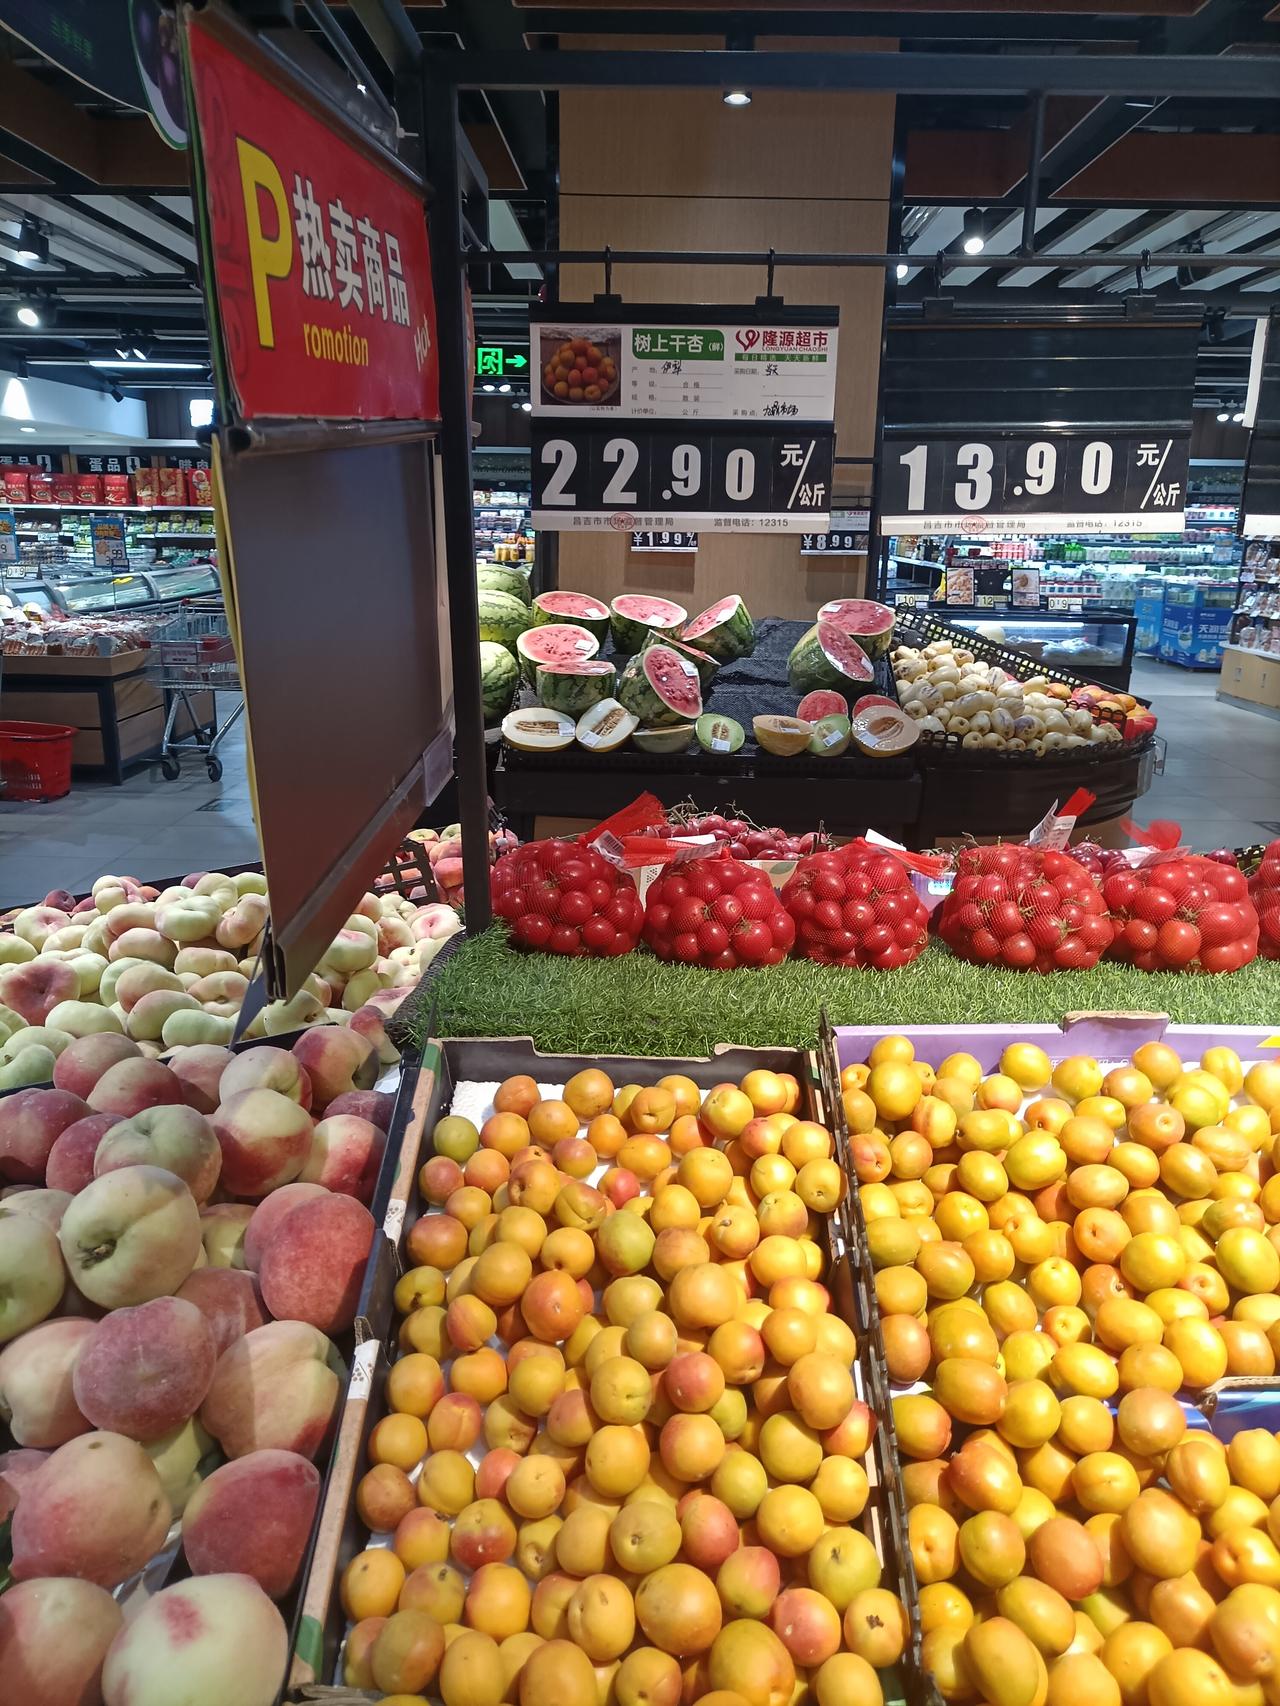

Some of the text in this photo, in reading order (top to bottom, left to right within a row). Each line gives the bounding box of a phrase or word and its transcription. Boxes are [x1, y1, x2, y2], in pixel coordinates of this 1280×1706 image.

[236, 137, 293, 348] P
[293, 173, 411, 327] 热卖商品
[303, 322, 369, 367] romotion
[413, 313, 431, 373] Hot
[634, 333, 704, 353] 树上干杏
[762, 330, 828, 347] 隆源超市
